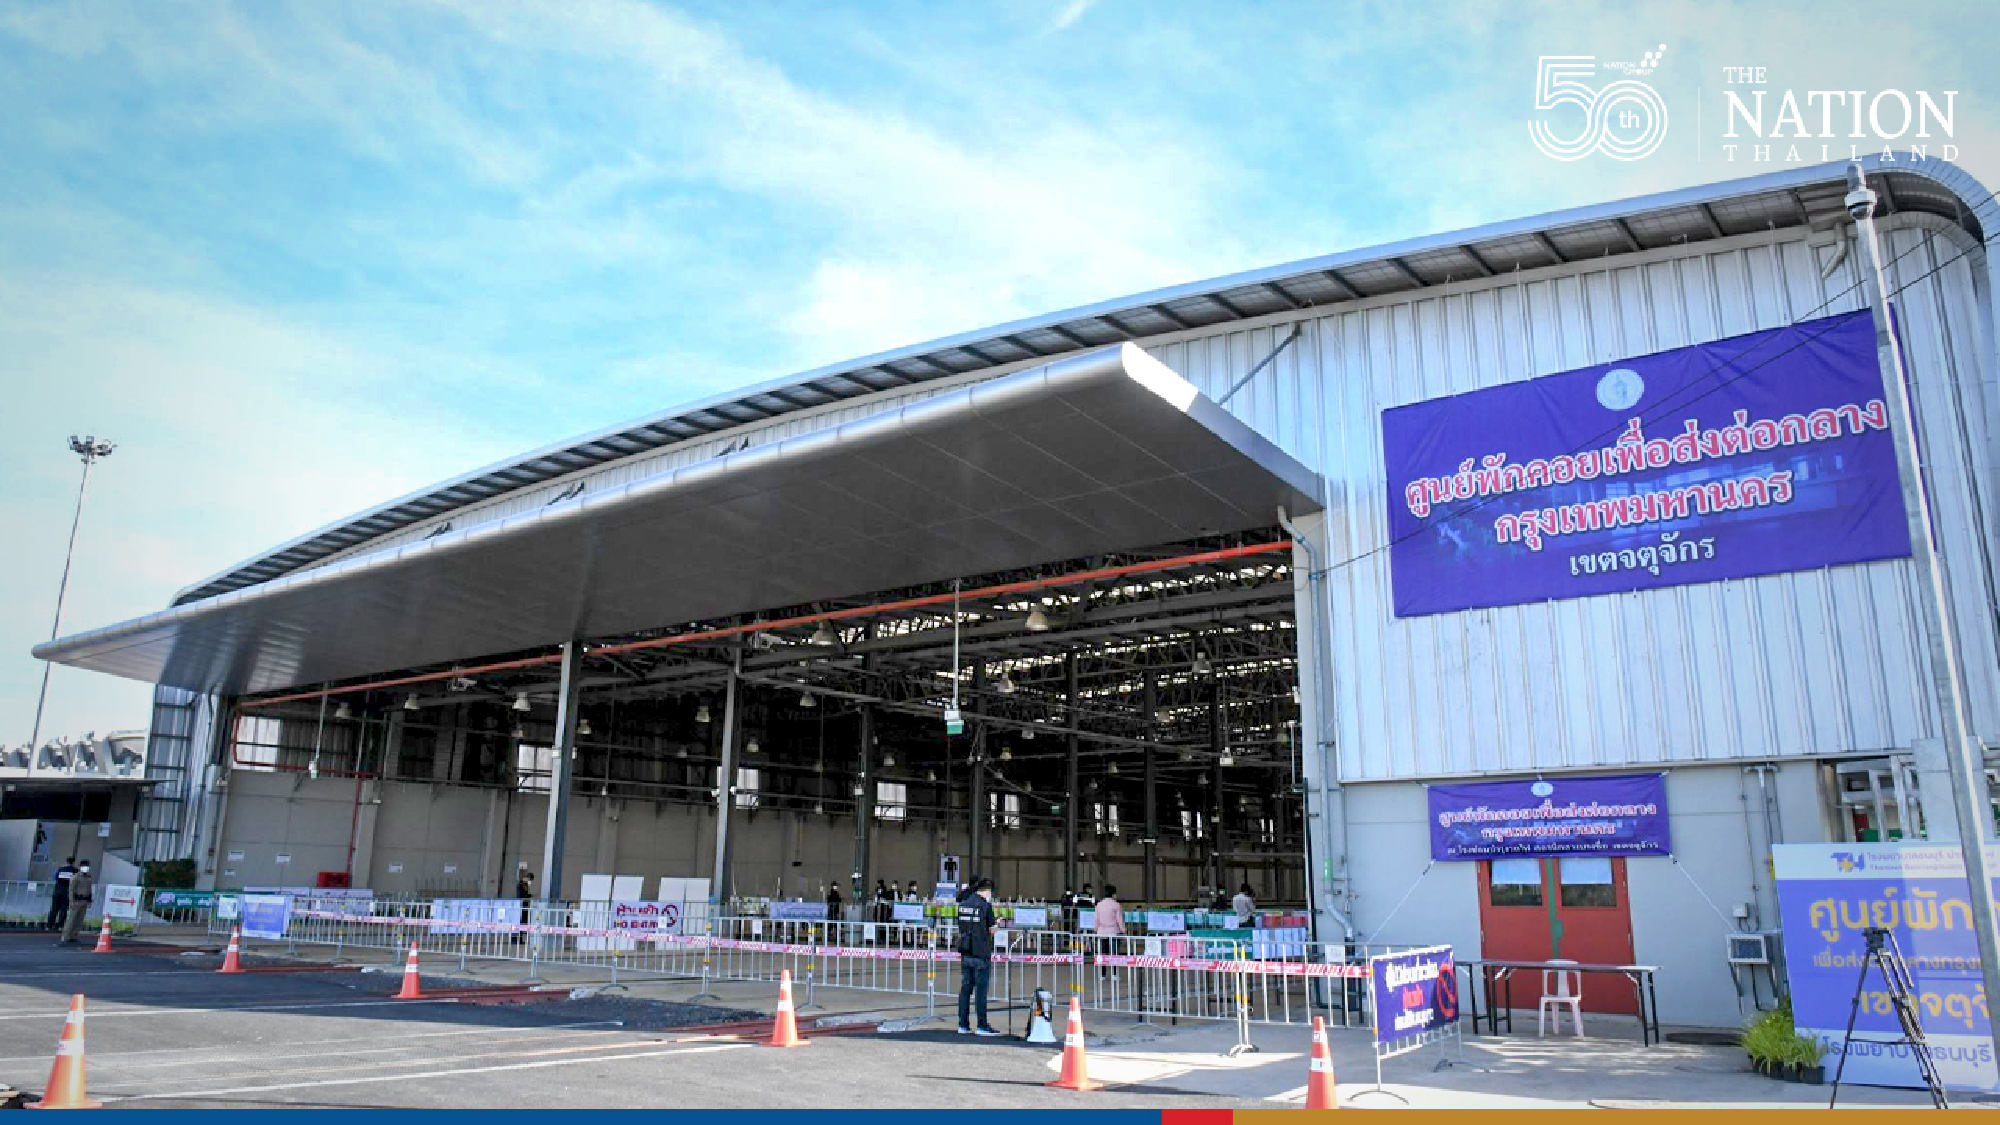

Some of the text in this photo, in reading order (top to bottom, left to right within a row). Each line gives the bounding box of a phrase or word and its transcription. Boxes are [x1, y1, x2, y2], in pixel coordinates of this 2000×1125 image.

[1404, 397, 1888, 518] ศูนย์พักคอยเพื่อส่งต่อกลาง
[1494, 469, 1795, 551] กรุงเทพมหานคร
[1569, 532, 1716, 577] เขตจตุจักร
